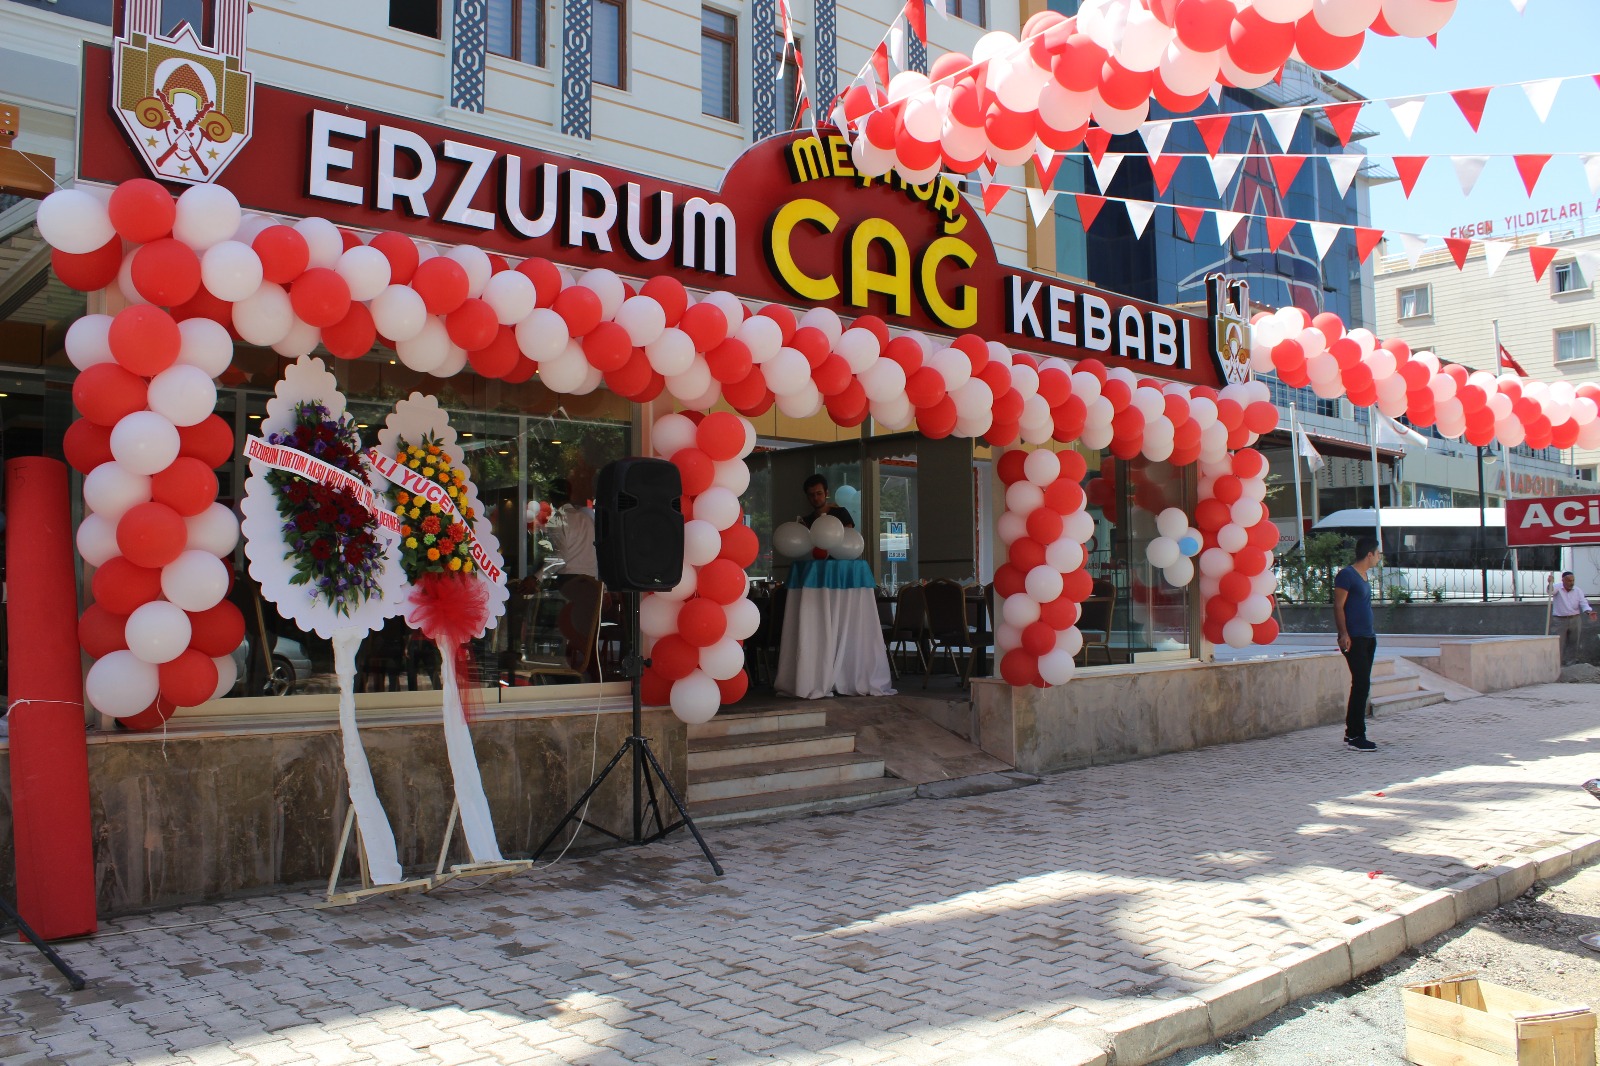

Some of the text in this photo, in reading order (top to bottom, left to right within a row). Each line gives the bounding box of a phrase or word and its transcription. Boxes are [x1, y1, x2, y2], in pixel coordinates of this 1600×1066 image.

[309, 109, 737, 276] ERZURUM
[1450, 219, 1493, 239] EKSEN
[1504, 201, 1583, 230] YILDIZLARI
[771, 198, 978, 329] CAĞ
[1012, 274, 1192, 370] KEBABI
[248, 439, 280, 465] ERZURUM
[278, 449, 309, 473] TORTUM
[306, 460, 327, 482] AKSU
